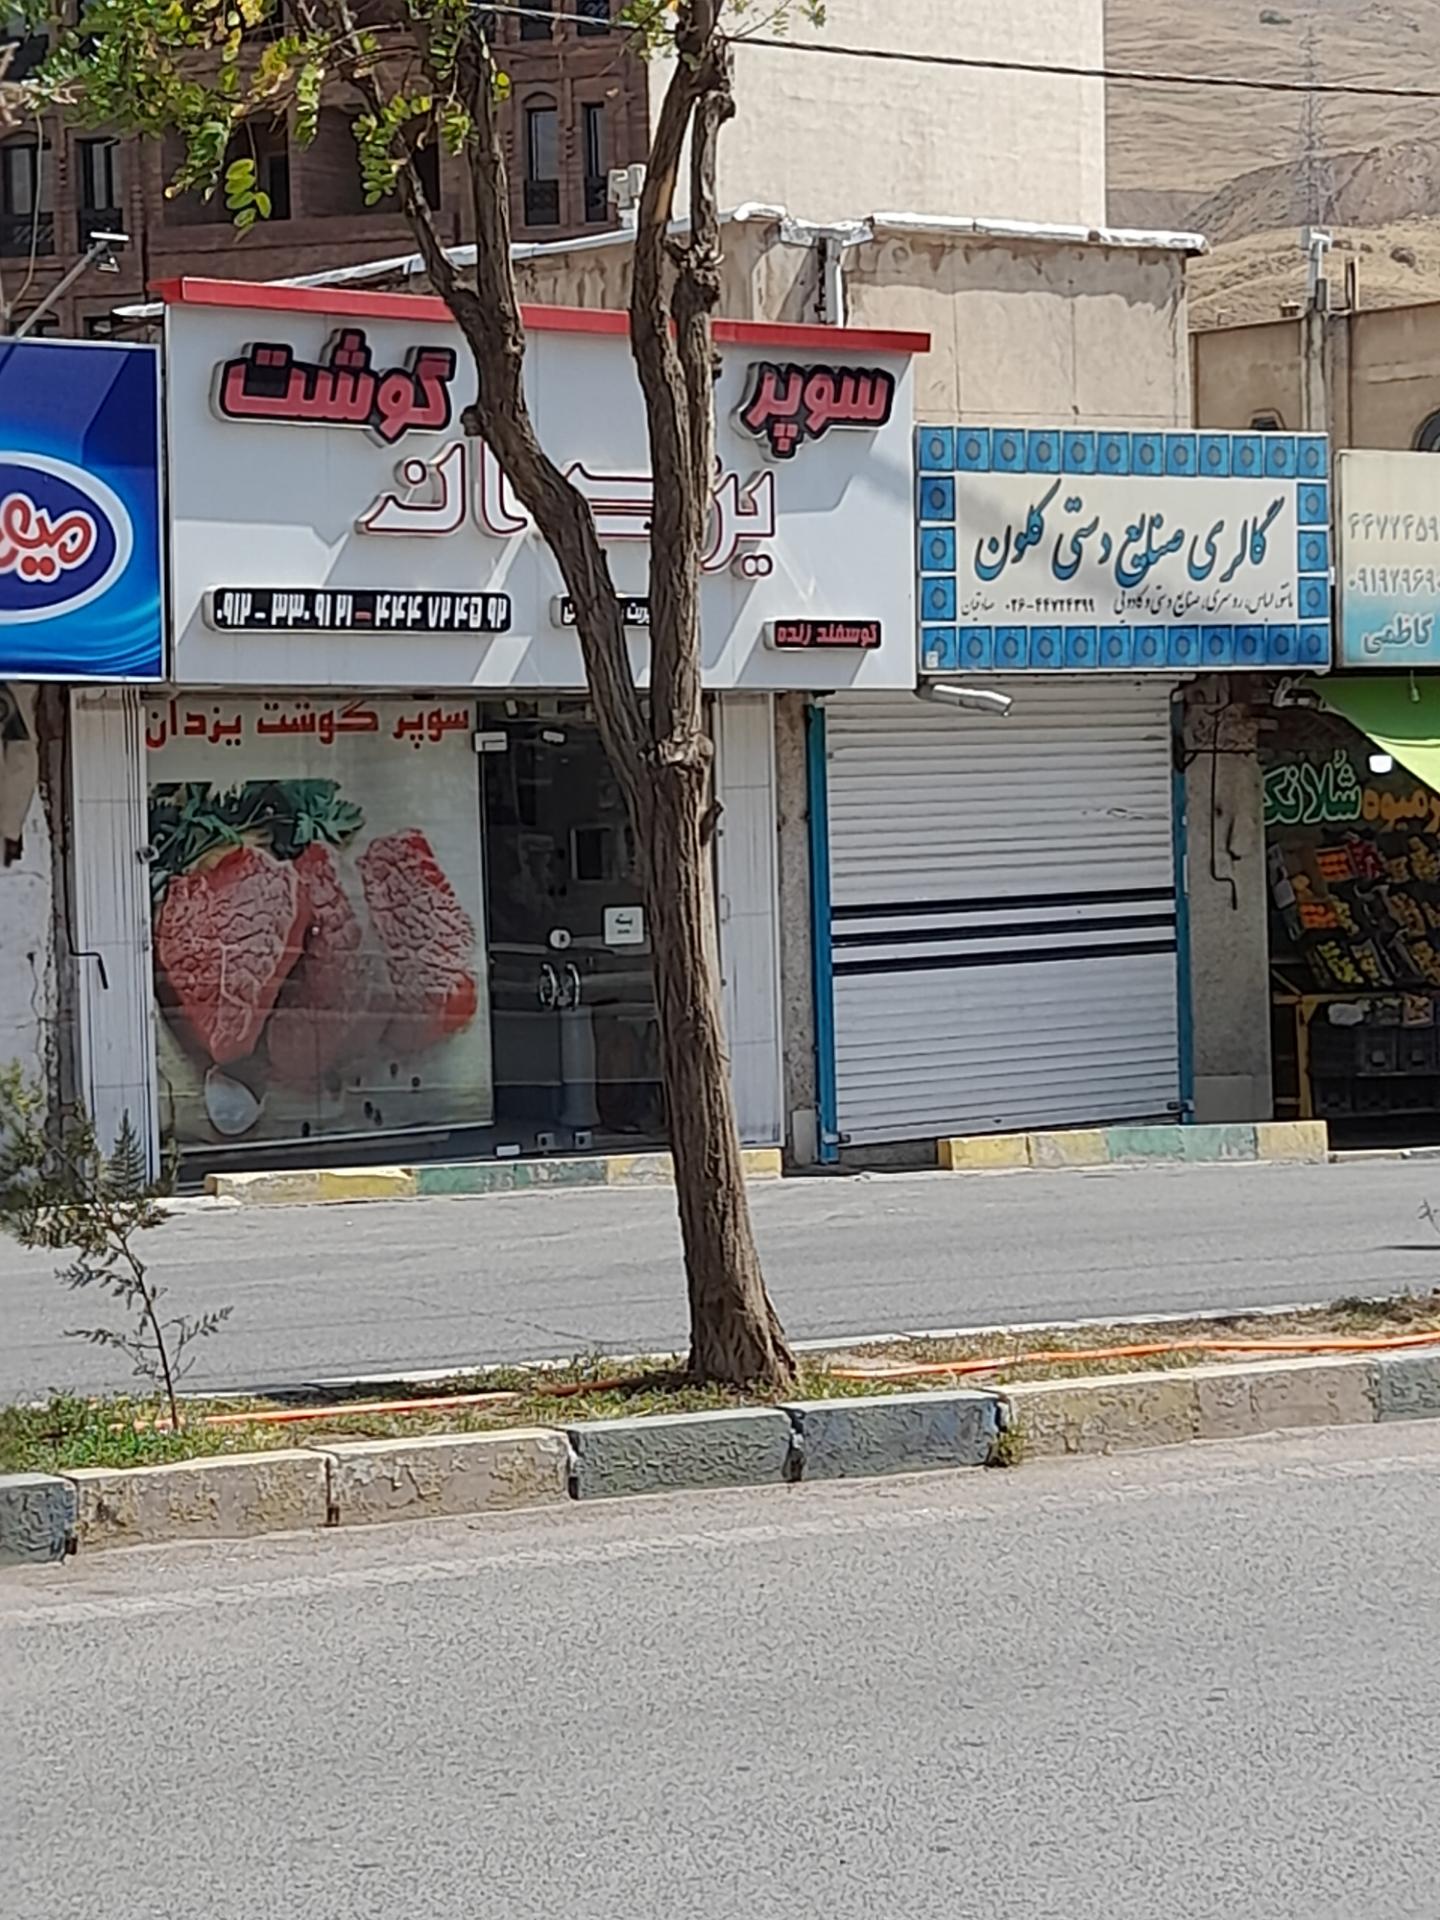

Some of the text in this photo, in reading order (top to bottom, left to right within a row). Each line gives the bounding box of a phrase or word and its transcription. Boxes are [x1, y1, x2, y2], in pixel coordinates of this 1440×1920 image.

[222, 330, 891, 455] سوپر گوشت
[974, 478, 1285, 588] گالری صنایع دستی کلون
[1363, 616, 1433, 655] کاظمی
[146, 700, 469, 749] سوپر گوشت یزدان
